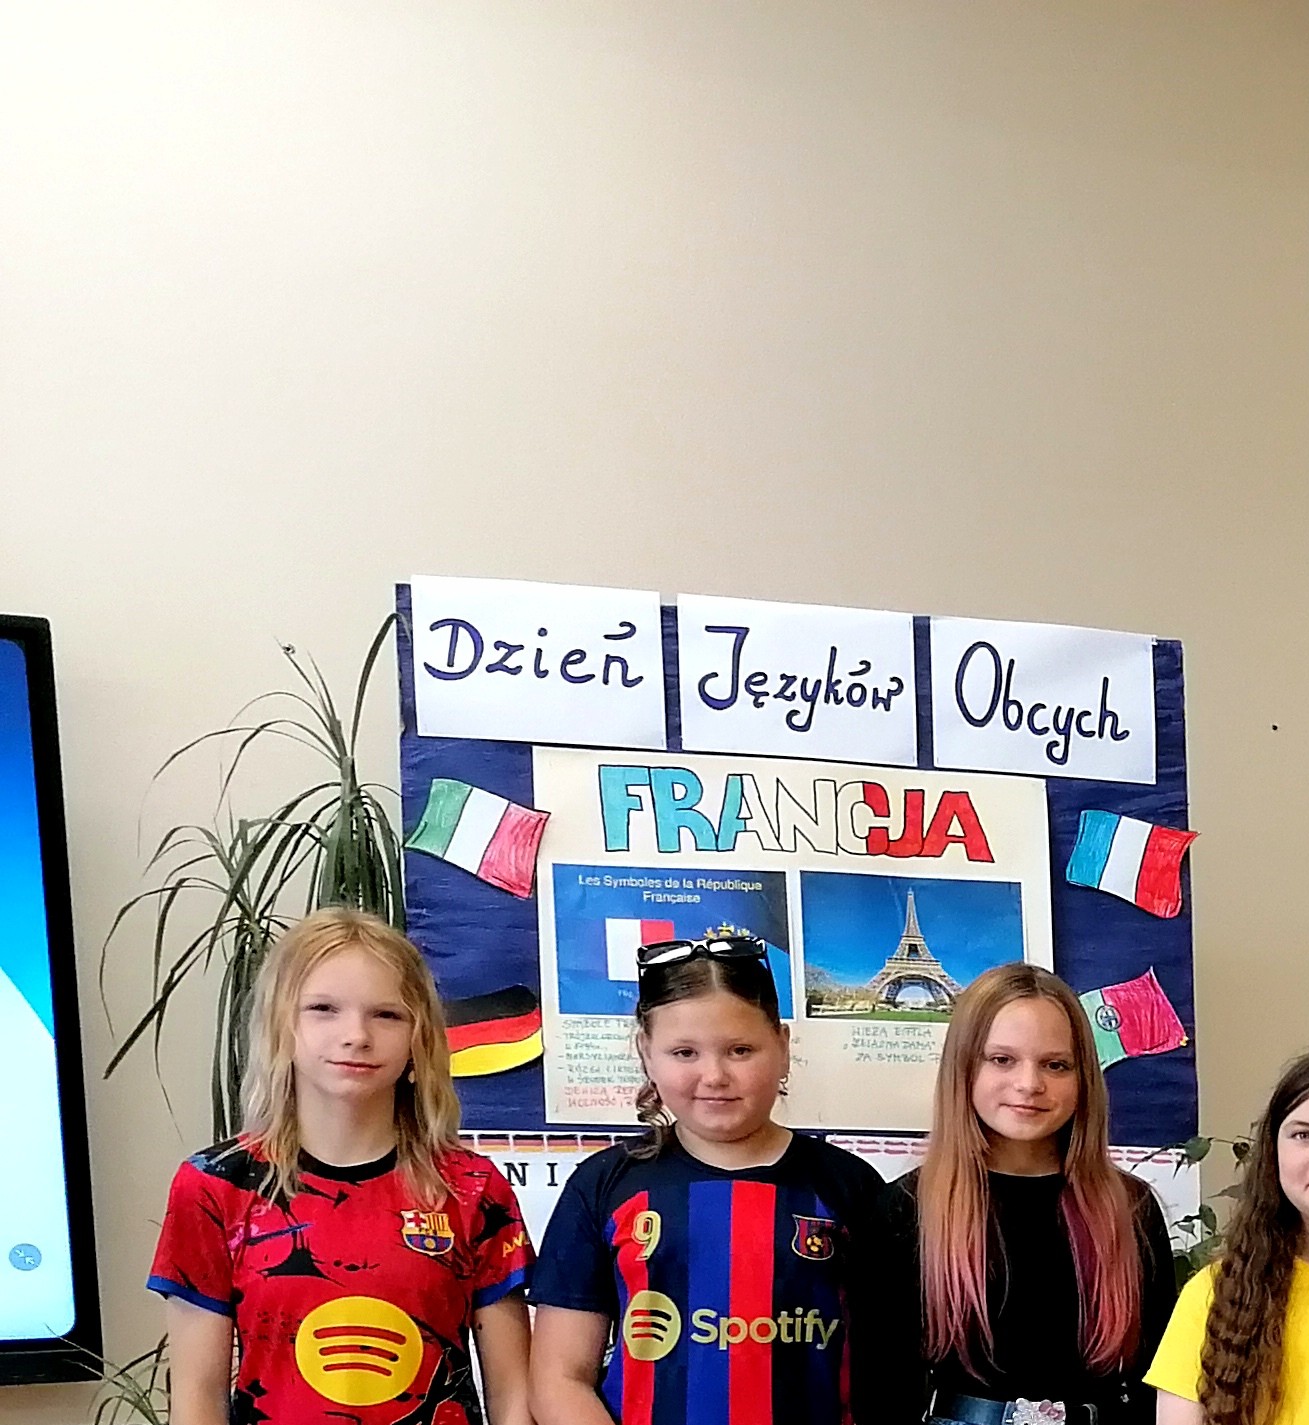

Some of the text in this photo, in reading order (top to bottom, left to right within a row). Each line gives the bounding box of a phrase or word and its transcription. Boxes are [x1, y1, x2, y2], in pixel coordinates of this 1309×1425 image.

[423, 617, 1131, 766] Dzień Języków Obcych
[597, 763, 996, 864] FRANCJA
[578, 874, 763, 893] Les Symboles de la République
[642, 890, 701, 904] Française
[631, 1210, 662, 1262] 9
[690, 1306, 840, 1351] Spotify
